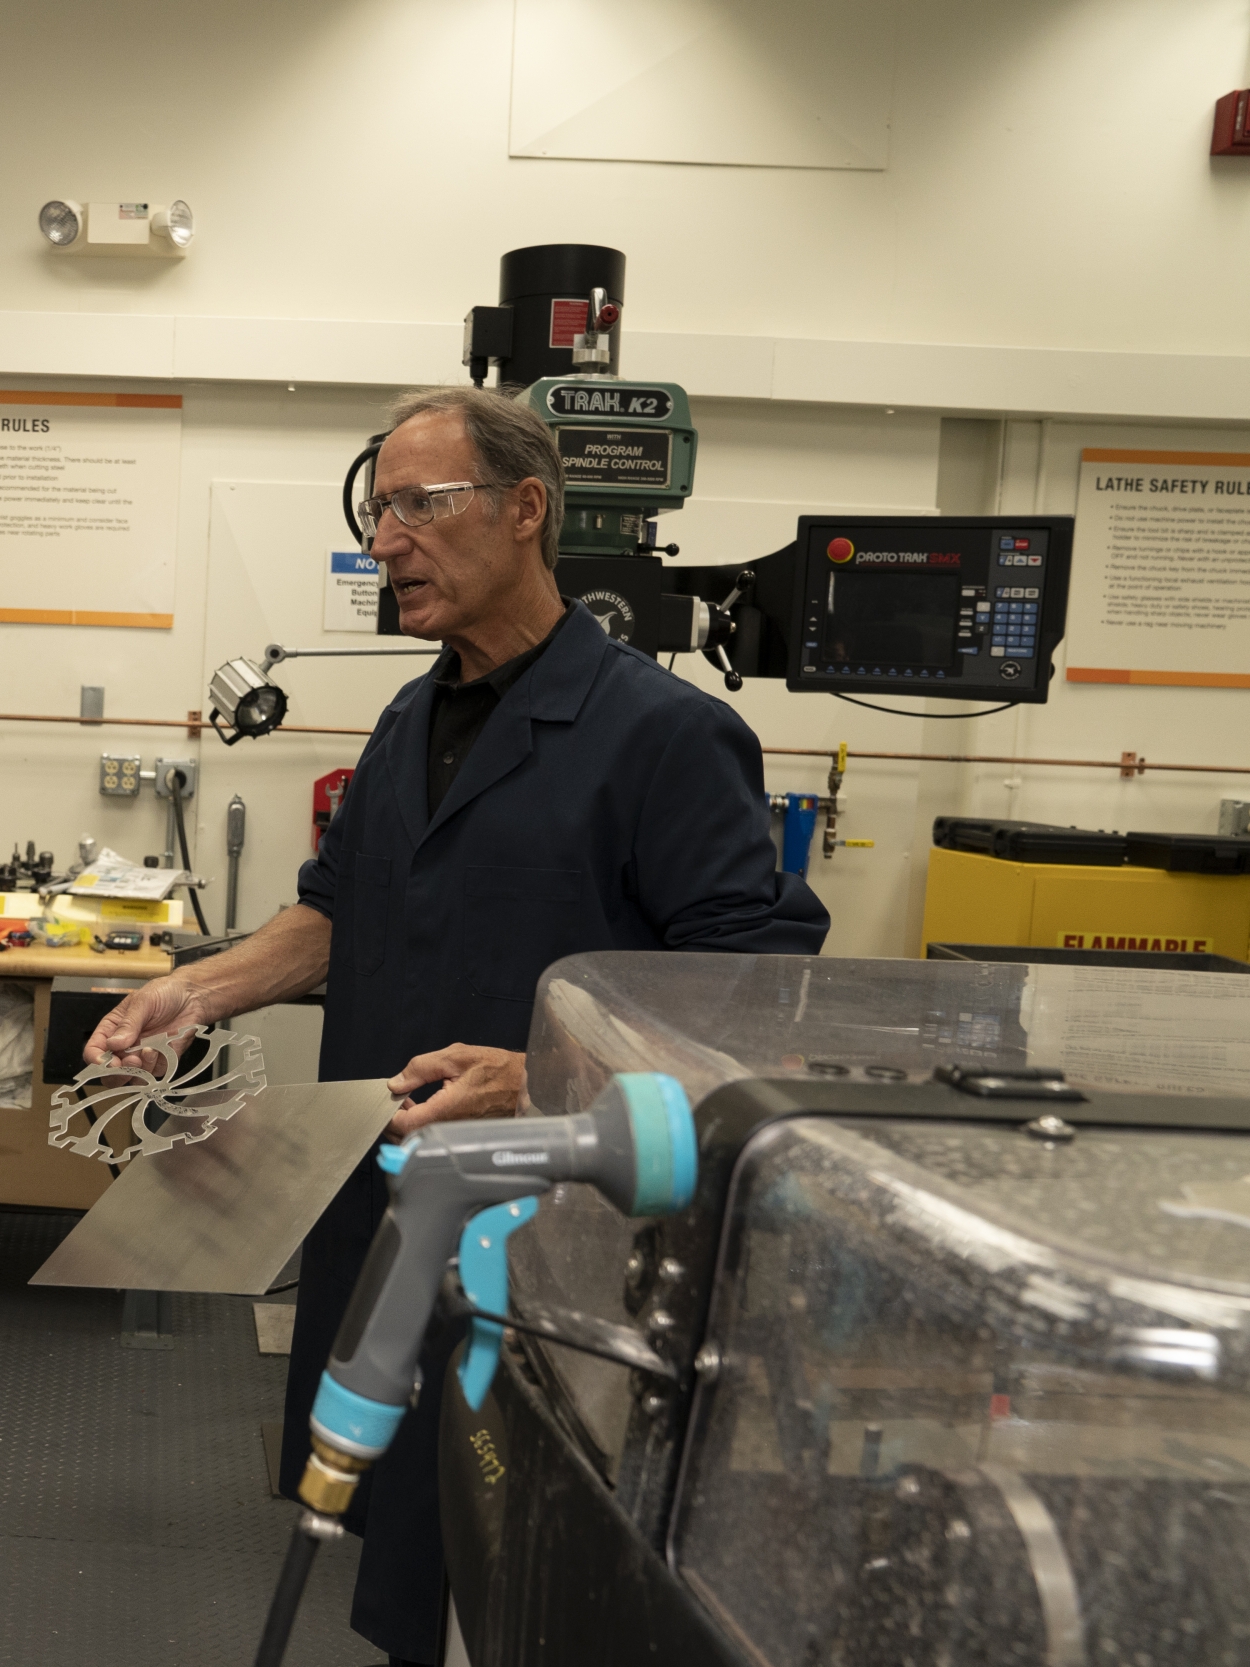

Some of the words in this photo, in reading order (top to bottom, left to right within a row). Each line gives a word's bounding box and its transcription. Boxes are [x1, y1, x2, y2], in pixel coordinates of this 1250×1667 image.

[561, 390, 620, 412] TRAK
[628, 398, 658, 414] K2
[1, 418, 50, 433] RULES
[584, 444, 643, 456] PROGRAM
[562, 456, 609, 469] SPINDLE
[610, 459, 664, 471] CONTROL
[1096, 476, 1144, 492] LATHE
[1149, 478, 1210, 494] SAFETY
[898, 552, 926, 564] TRAK
[930, 553, 960, 564] SMX
